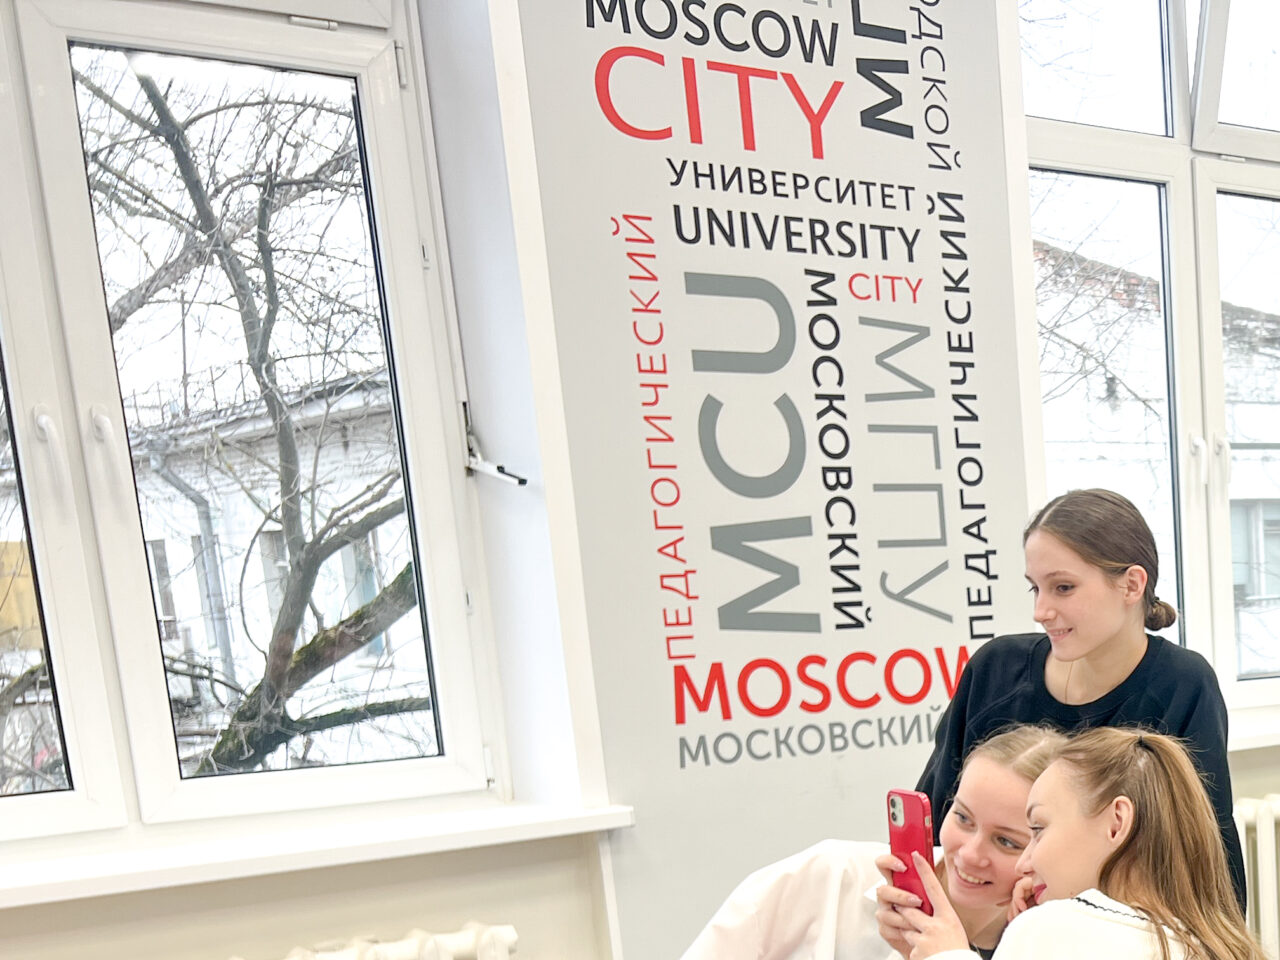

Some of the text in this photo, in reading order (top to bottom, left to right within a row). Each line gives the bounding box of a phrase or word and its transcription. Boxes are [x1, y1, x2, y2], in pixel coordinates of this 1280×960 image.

[585, 0, 839, 67] MOSCOW
[594, 46, 845, 160] CITY
[909, 0, 962, 171] ДСКОЙ
[666, 157, 916, 212] УНИВЕРСИТЕТ
[673, 204, 921, 263] UNIVERSITY
[848, 272, 923, 304] CITY
[610, 214, 698, 660] ПЕДАГОГИЧЕСКИЙ
[684, 271, 822, 634] MCU
[804, 268, 873, 632] МОСКОВСКИЙ
[858, 315, 954, 624] МГПУ
[926, 191, 999, 640] ПЕДАГОГИЧЕСКИЙ
[678, 704, 944, 769] МОСКОВСКИЙ
